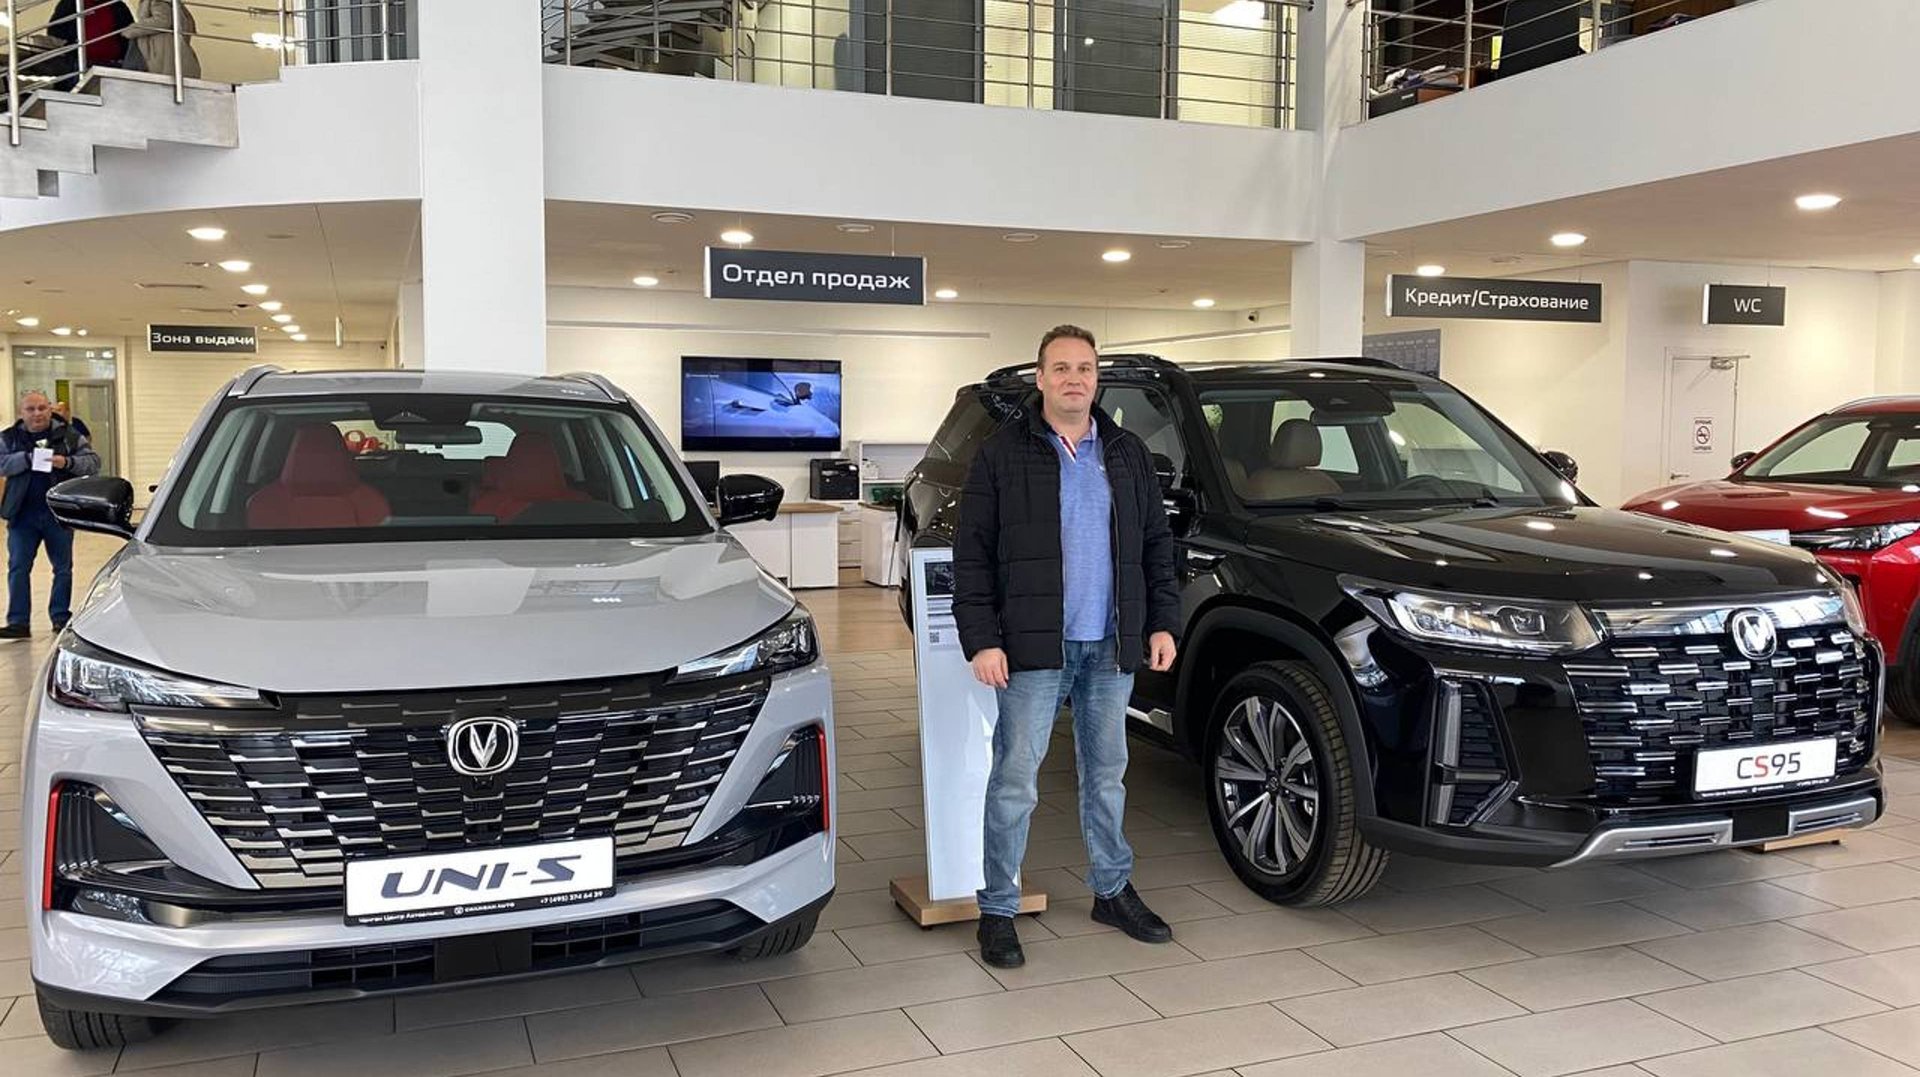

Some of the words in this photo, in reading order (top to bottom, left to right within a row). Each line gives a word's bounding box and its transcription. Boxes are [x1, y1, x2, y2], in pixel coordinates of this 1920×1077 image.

[722, 263, 804, 287] Отдел
[812, 271, 911, 291] продаж
[1405, 288, 1590, 310] Кредит/Страхование
[1733, 298, 1762, 313] WC
[151, 332, 191, 344] Зона
[195, 335, 255, 347] выдачи
[1737, 752, 1801, 780] CS95
[381, 855, 582, 899] UNI-S
